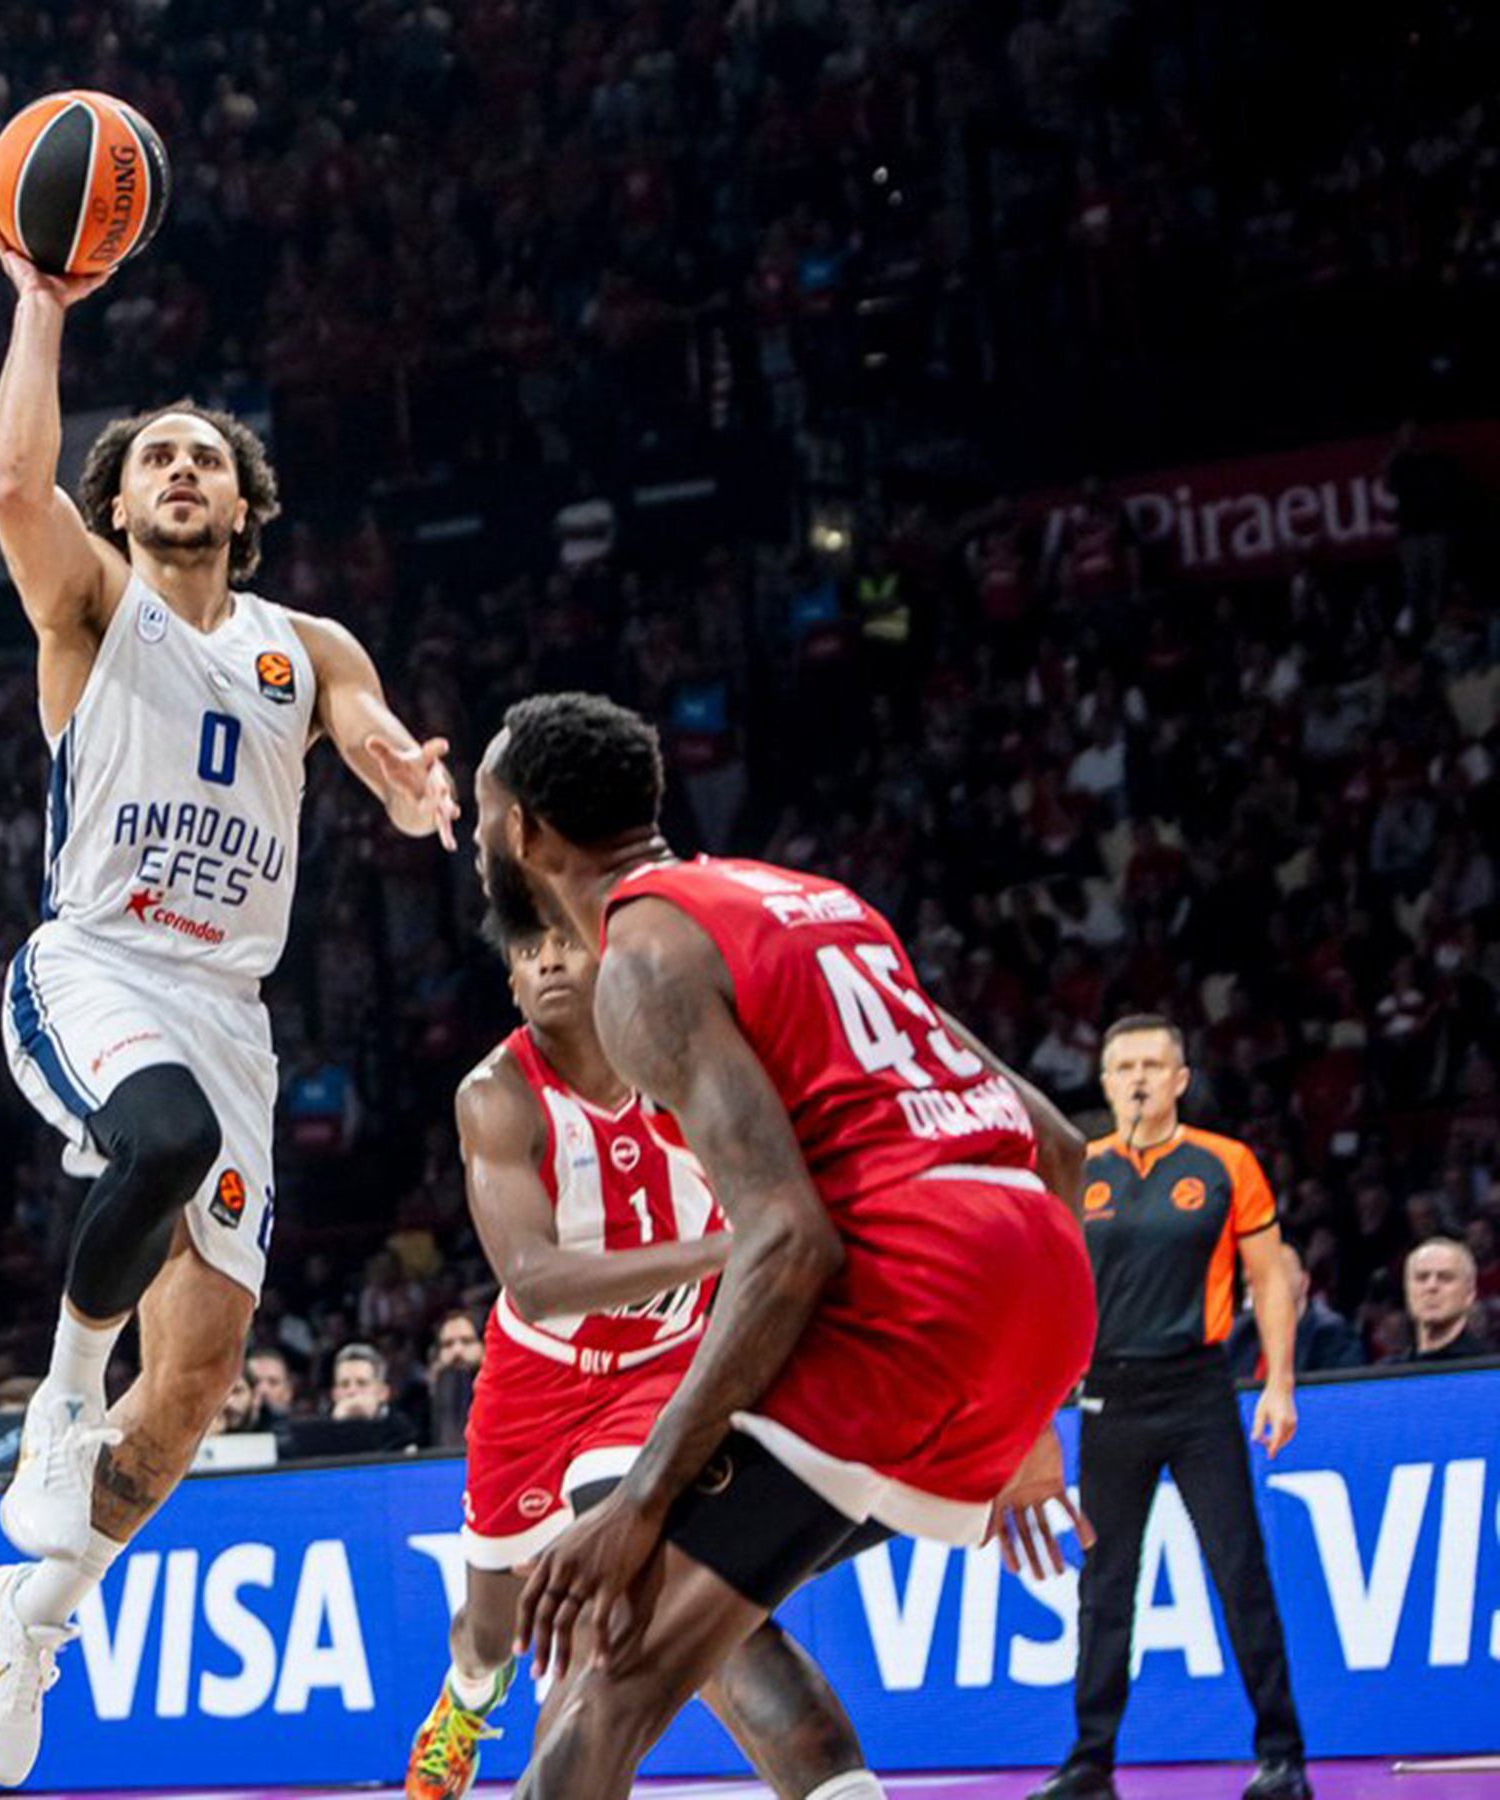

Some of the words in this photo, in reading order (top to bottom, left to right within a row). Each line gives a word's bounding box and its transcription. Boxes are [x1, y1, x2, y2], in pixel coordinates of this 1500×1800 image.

[1124, 474, 1399, 566] Piraeus
[198, 710, 242, 787] 0
[113, 802, 286, 882] ANADOLU
[138, 846, 253, 906] EFES
[815, 943, 983, 1089] 45
[629, 1187, 654, 1244] 1
[579, 1347, 613, 1375] OLY
[1266, 1458, 1500, 1671] VI
[74, 1540, 376, 1721] VISA
